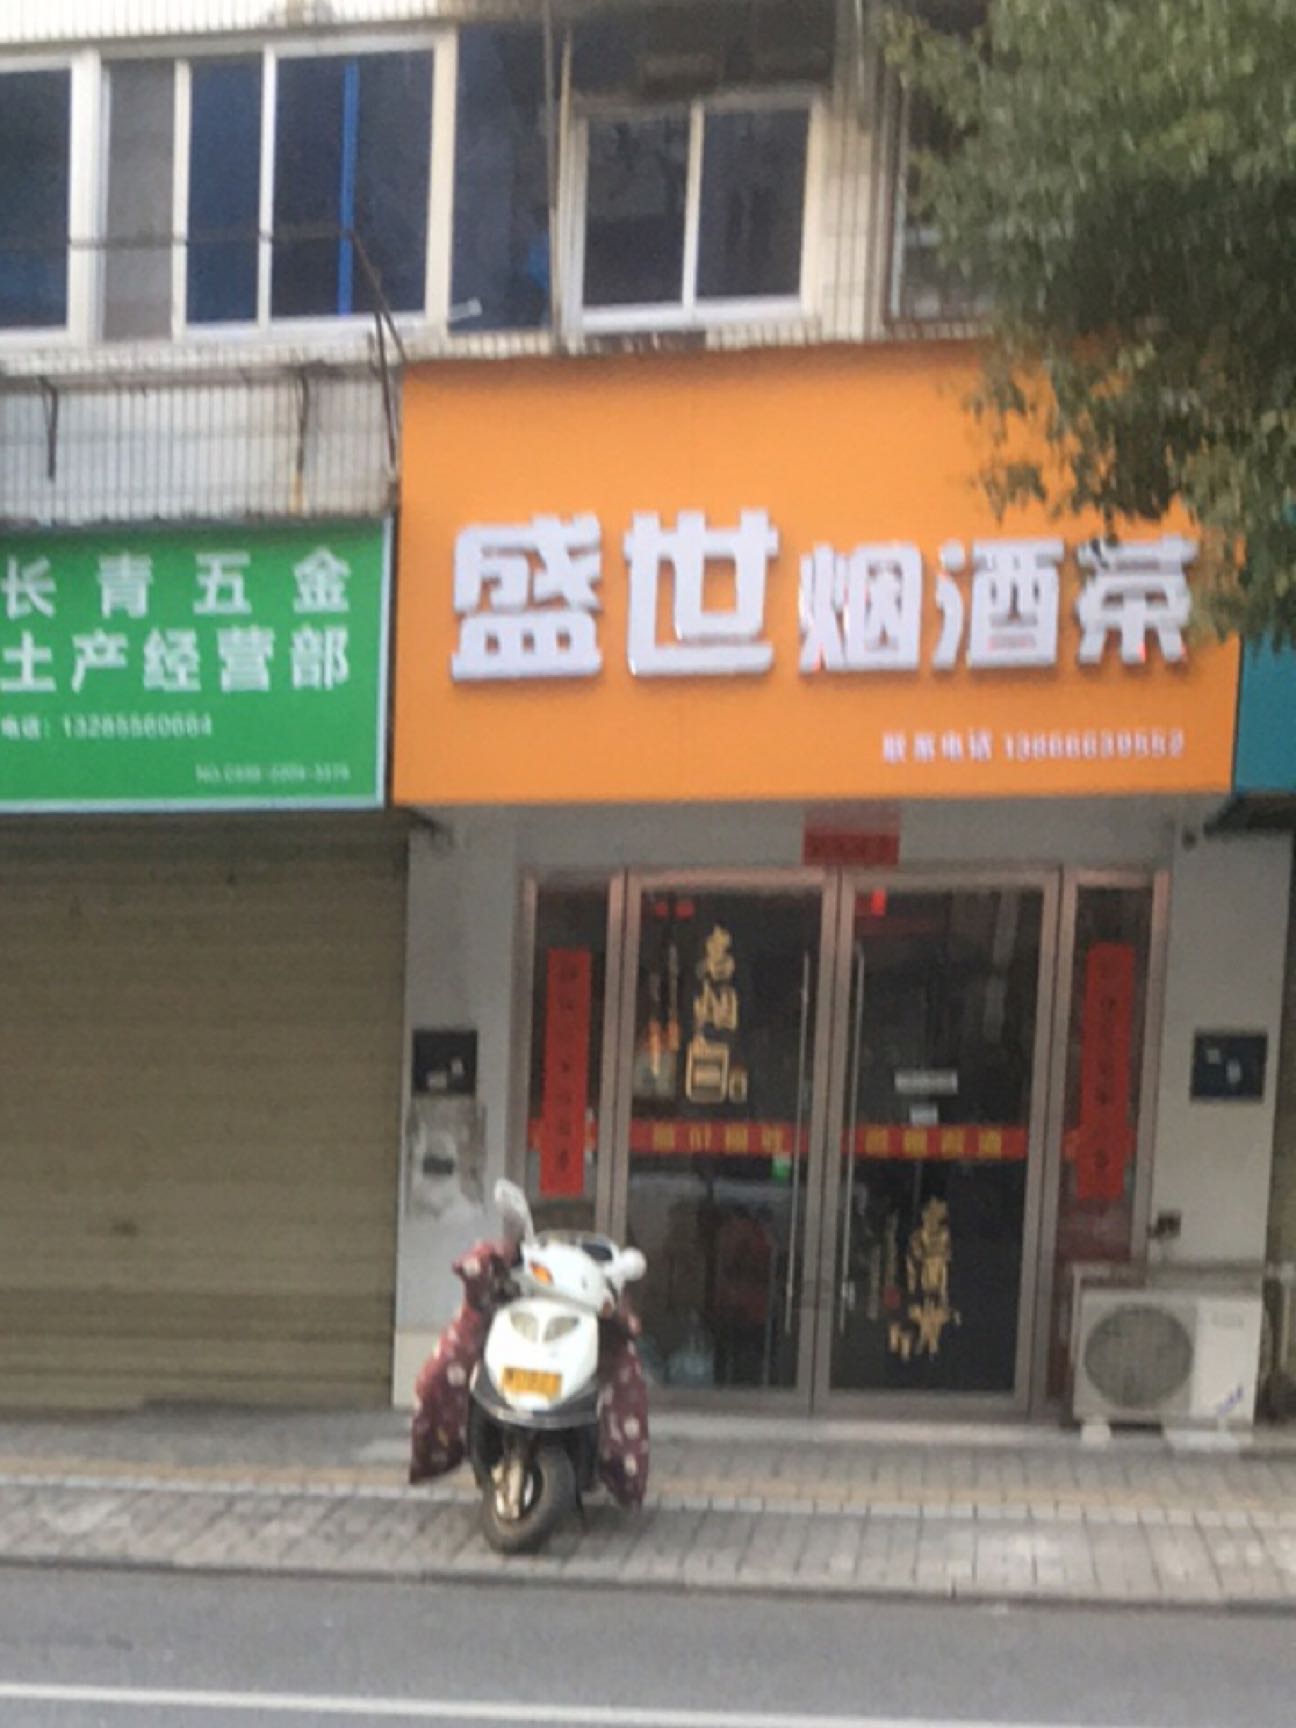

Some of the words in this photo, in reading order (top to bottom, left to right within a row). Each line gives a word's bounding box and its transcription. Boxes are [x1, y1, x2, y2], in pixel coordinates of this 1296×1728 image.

[0, 547, 352, 620] 长青五金
[451, 508, 1199, 684] 盛世烟酒茶
[0, 624, 352, 694] 土产经营部
